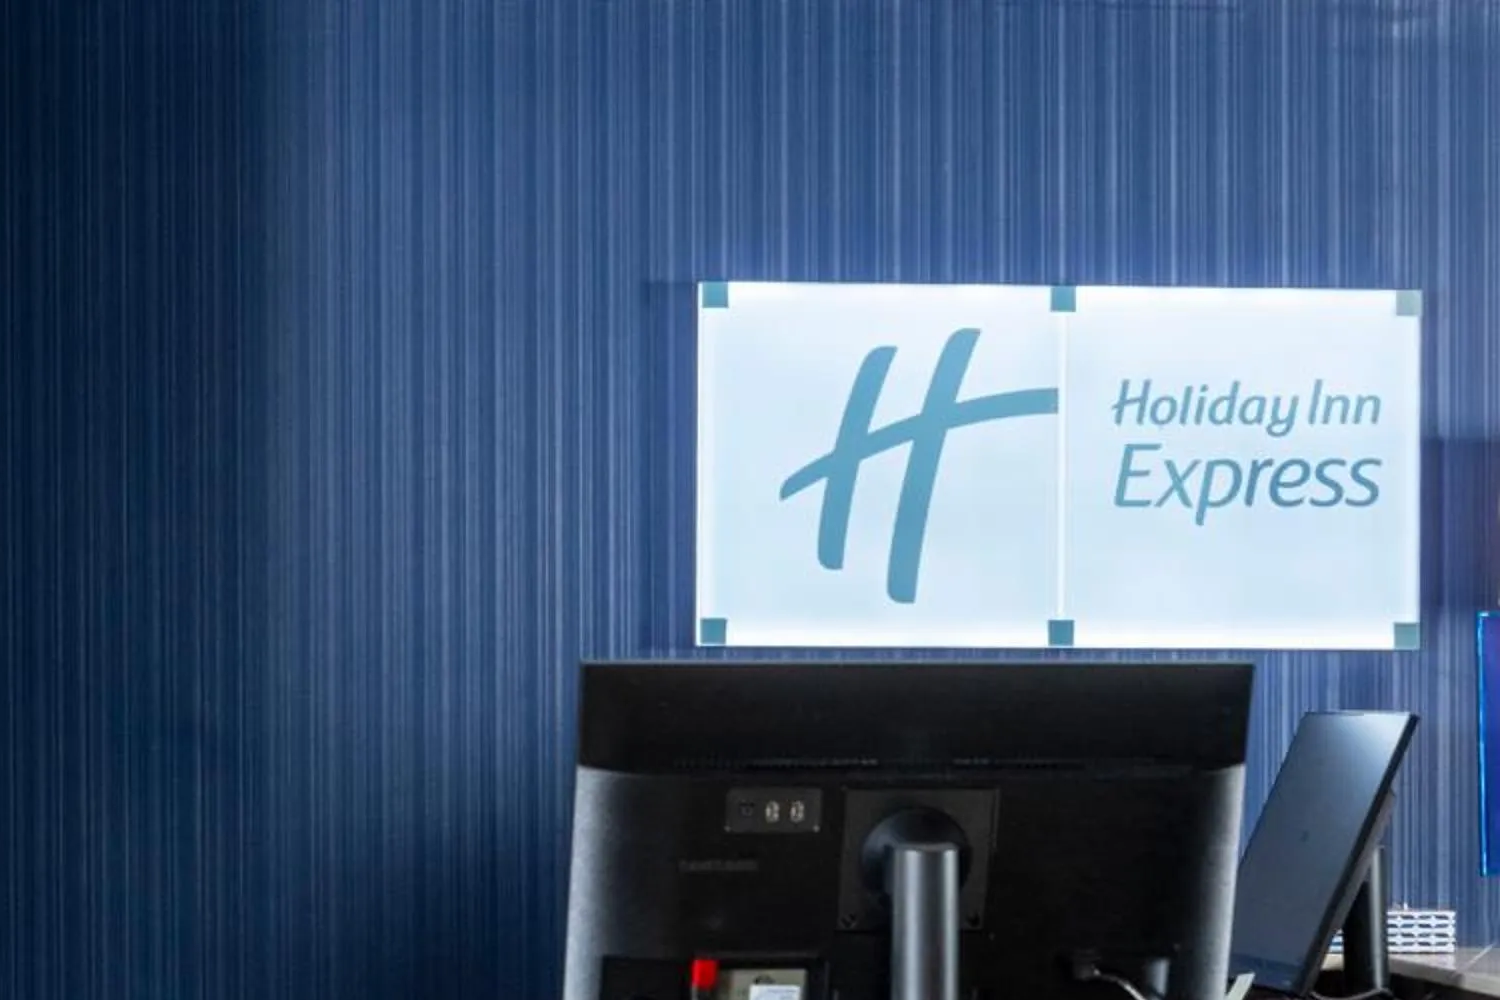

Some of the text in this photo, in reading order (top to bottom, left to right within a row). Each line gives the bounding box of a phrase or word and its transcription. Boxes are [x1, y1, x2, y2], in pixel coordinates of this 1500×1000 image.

[1111, 379, 1382, 437] Holiday Inn
[779, 327, 1059, 604] H
[1114, 443, 1383, 526] Express
